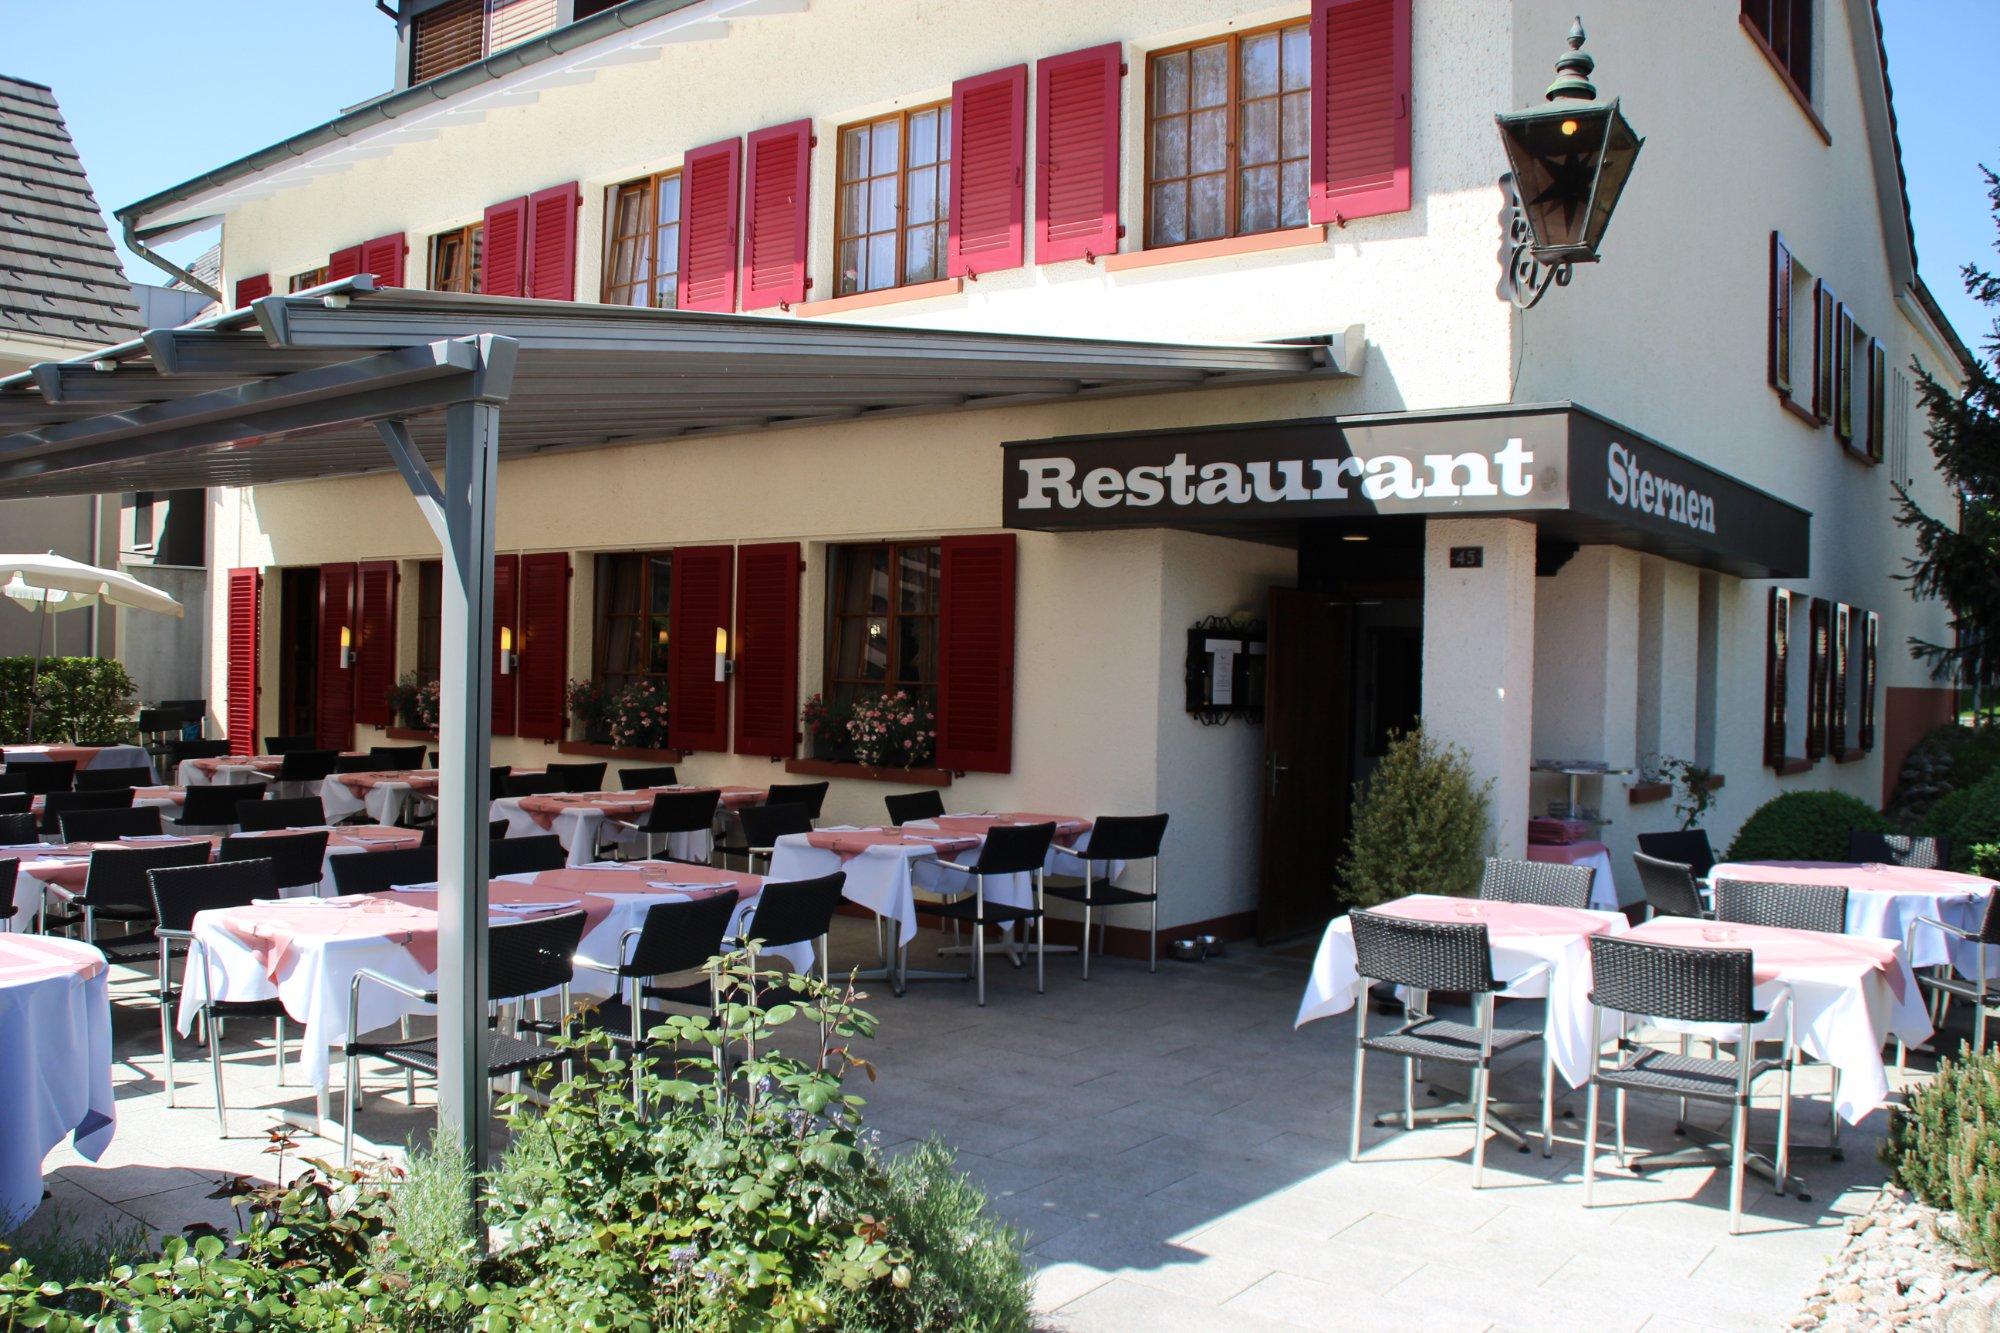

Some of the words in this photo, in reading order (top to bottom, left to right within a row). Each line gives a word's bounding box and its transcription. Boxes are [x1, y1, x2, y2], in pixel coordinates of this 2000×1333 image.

[1018, 438, 1533, 509] Restaurant
[1608, 442, 1715, 533] Sternen
[1455, 550, 1476, 565] 45
